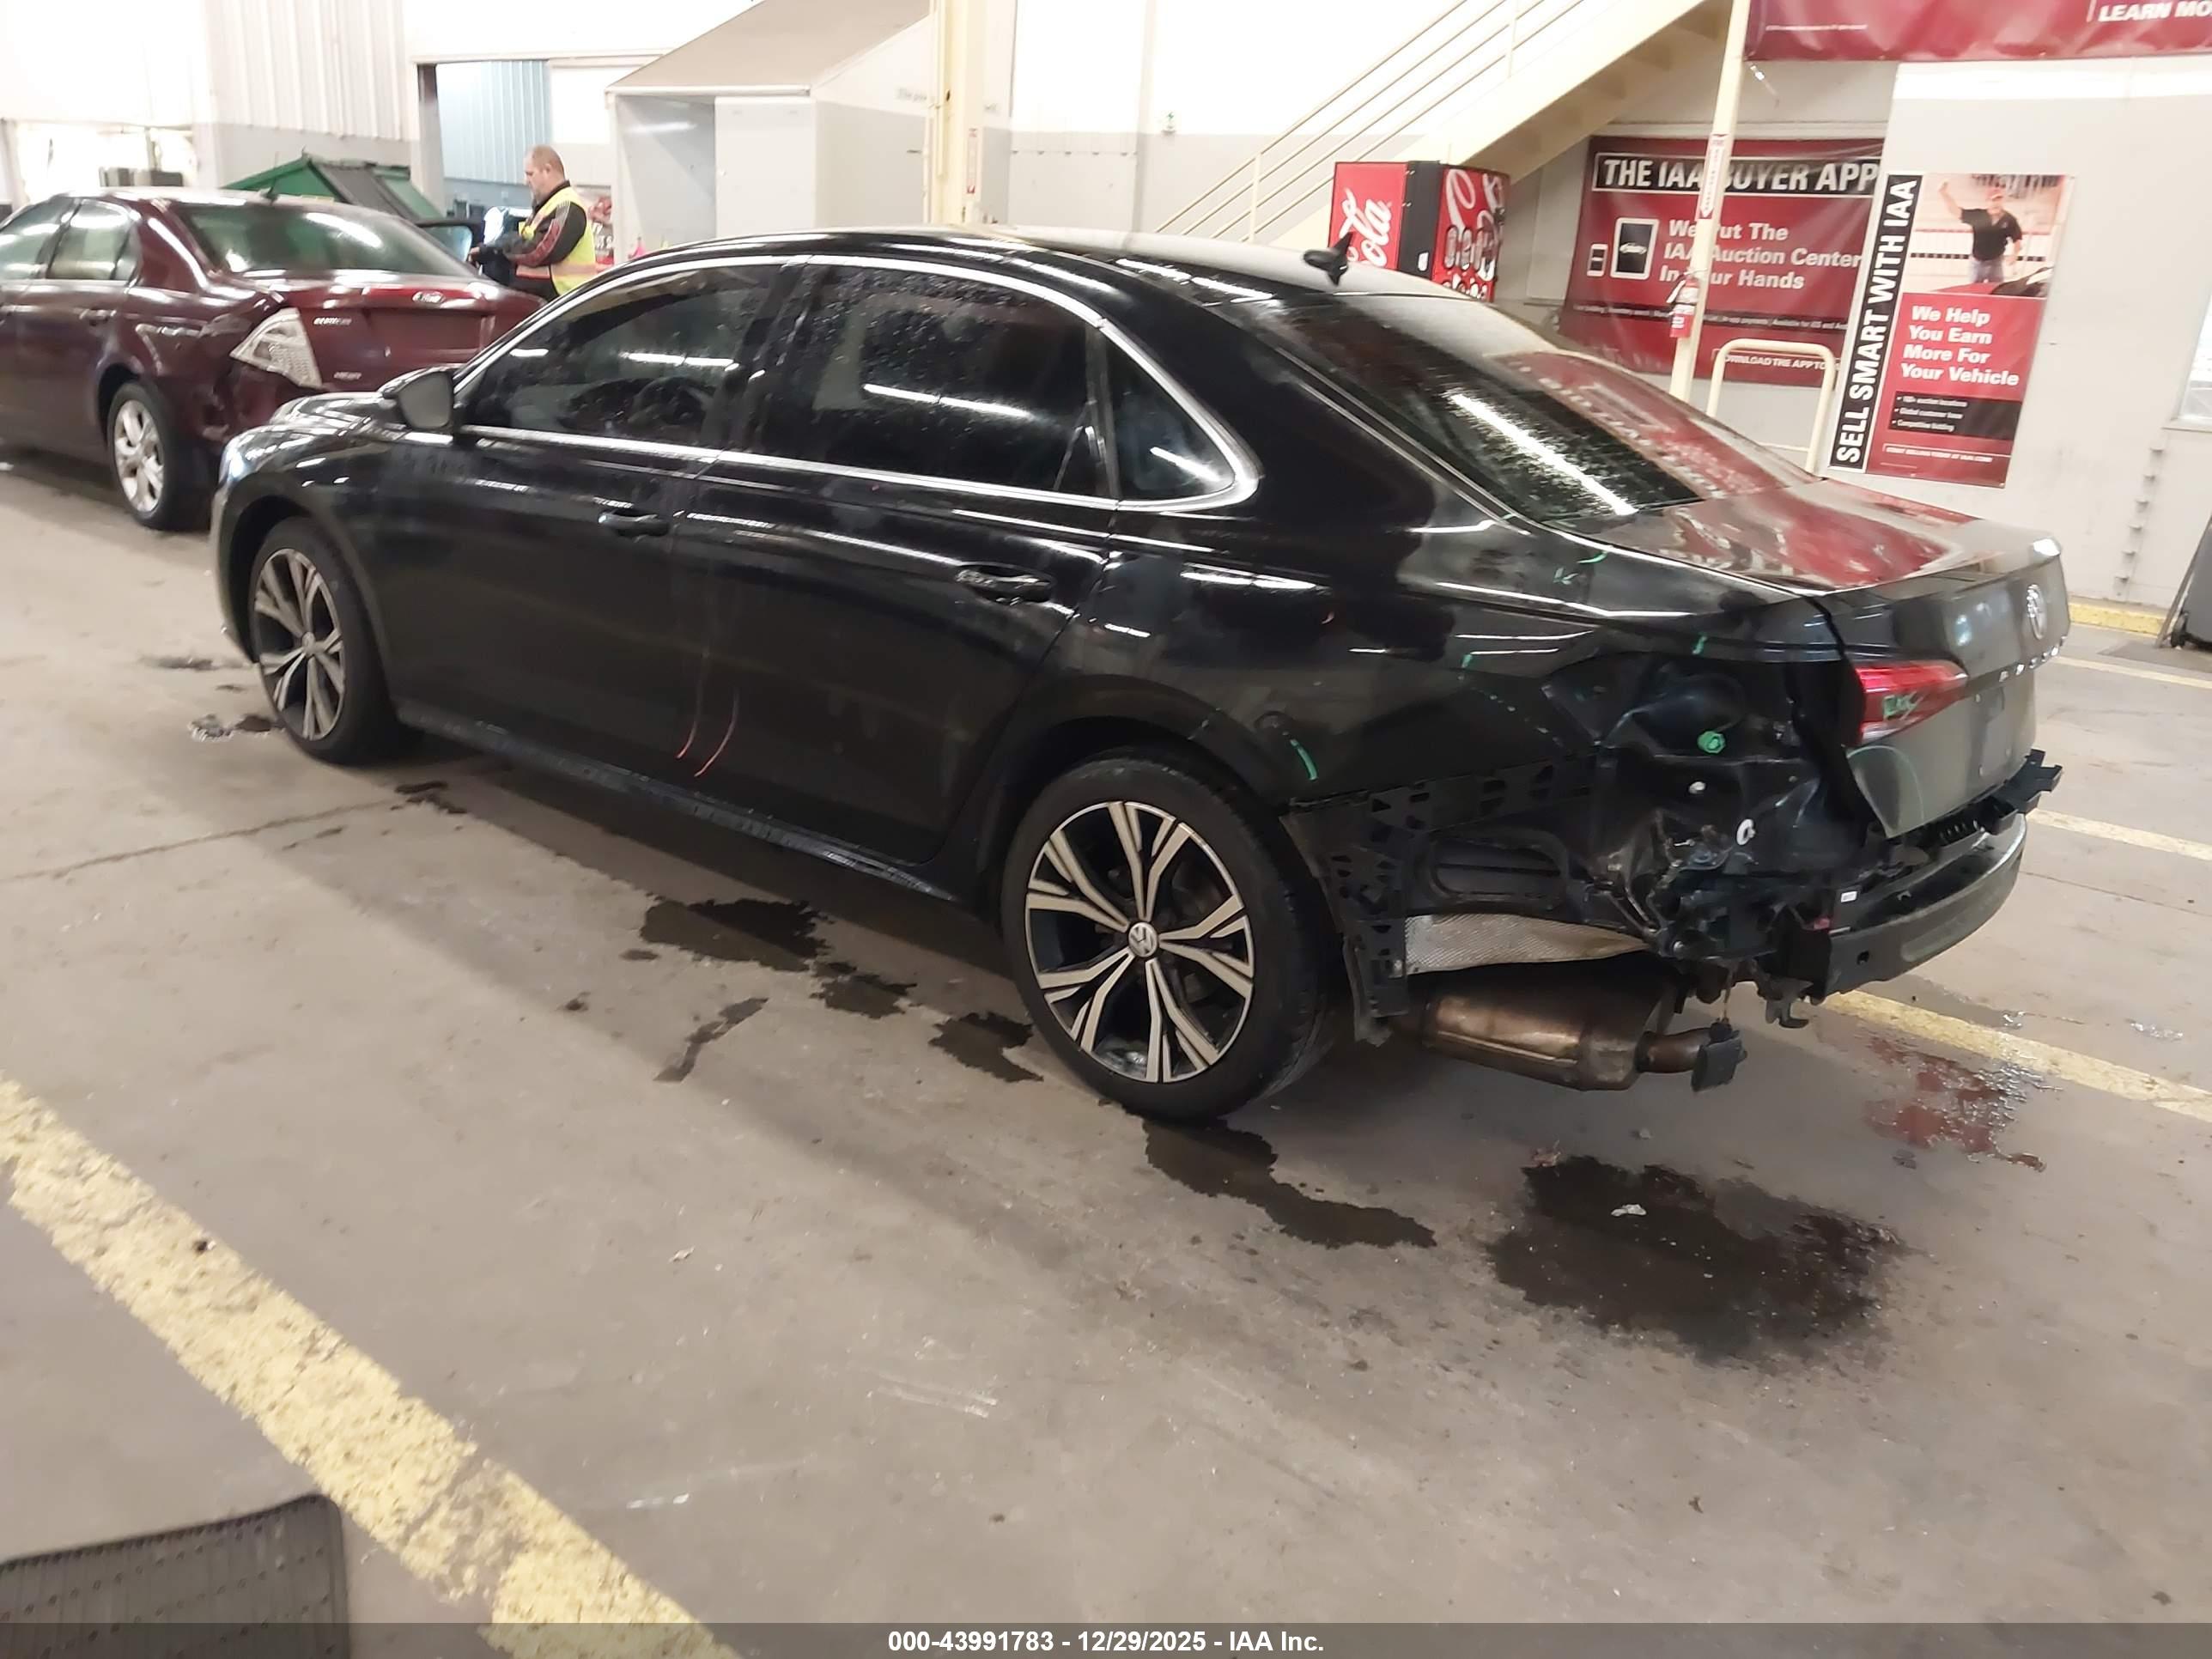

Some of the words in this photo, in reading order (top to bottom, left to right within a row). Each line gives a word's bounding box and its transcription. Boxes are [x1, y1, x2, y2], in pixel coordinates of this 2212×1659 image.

[2098, 3, 2172, 22] LEARN
[2174, 1, 2212, 17] MO
[1604, 159, 1653, 186] THE
[1814, 163, 1879, 191] APP
[1883, 180, 1917, 227] IAA
[1669, 220, 1697, 237] We
[1717, 224, 1743, 240] ut
[1749, 223, 1789, 240] The
[1711, 244, 1784, 264] Auction
[1659, 264, 1680, 283] In
[1738, 269, 1805, 290] Hands
[1868, 234, 1906, 305] WITH
[1911, 305, 1941, 322] We
[1945, 307, 1991, 327] Help
[1909, 325, 1944, 342] You
[1948, 327, 1993, 345] Earn
[1849, 309, 1889, 401] SMART
[1903, 343, 1953, 362] More
[1957, 347, 1990, 364] For
[1900, 362, 1944, 380] Your
[1948, 366, 2020, 386] Vehicle
[1837, 406, 1870, 464] SELL
